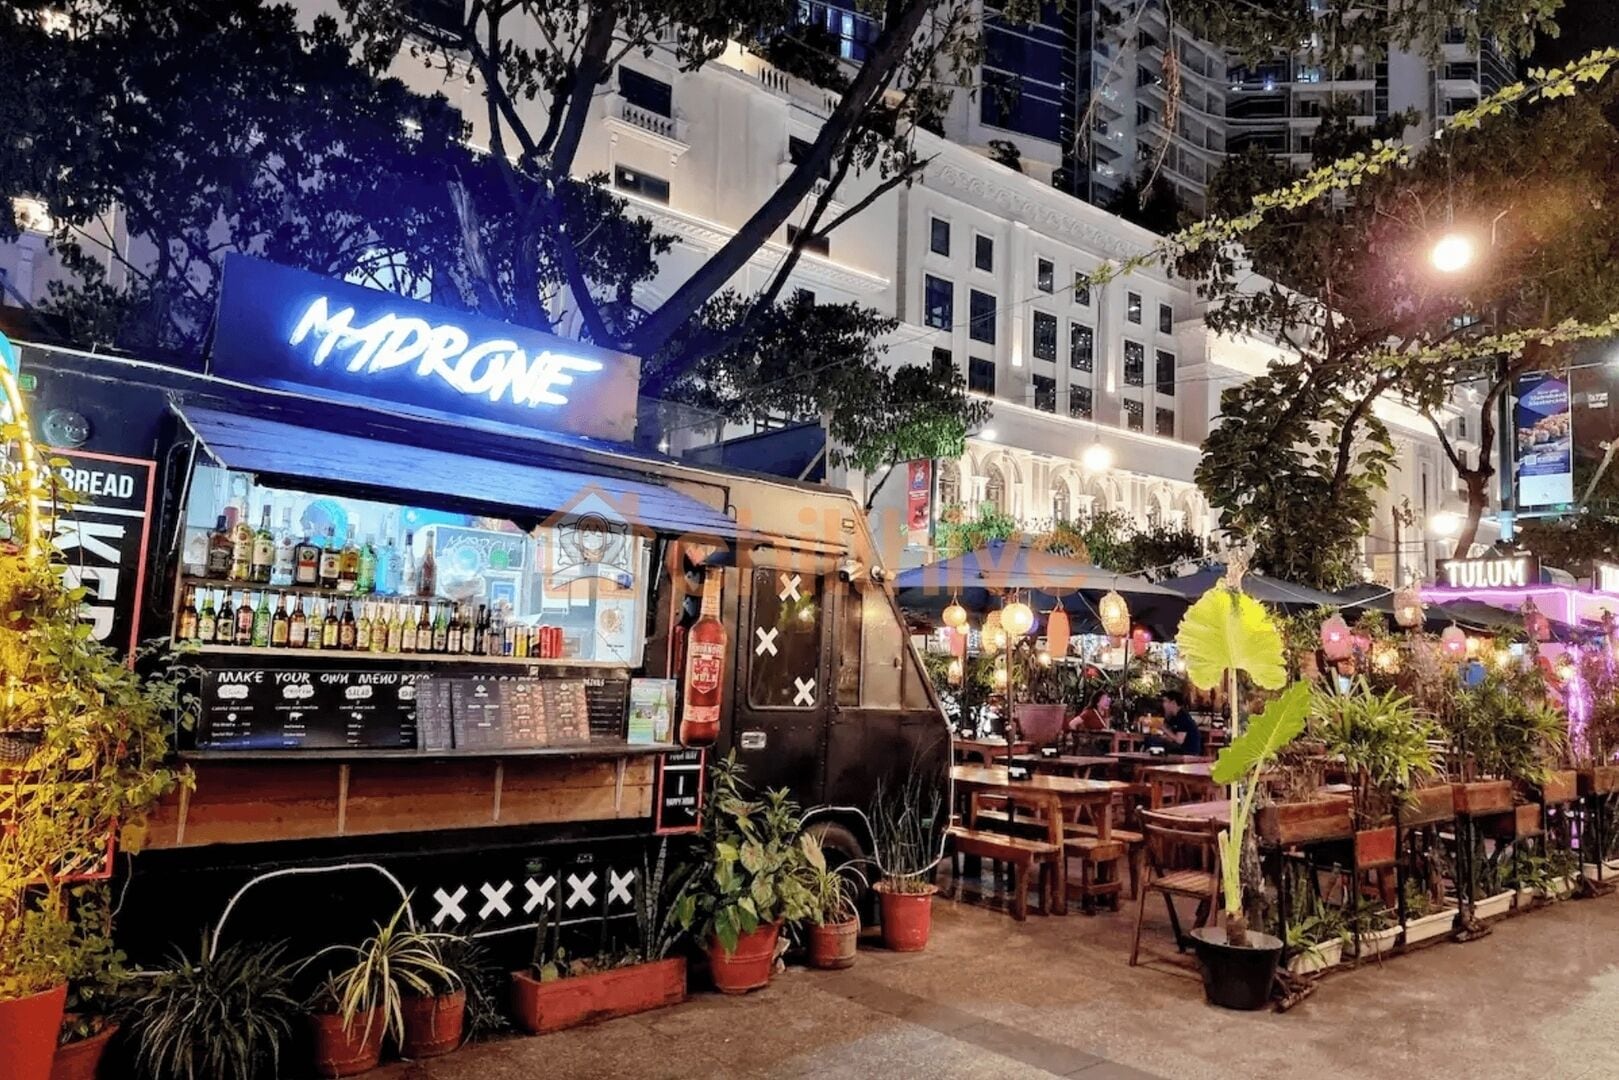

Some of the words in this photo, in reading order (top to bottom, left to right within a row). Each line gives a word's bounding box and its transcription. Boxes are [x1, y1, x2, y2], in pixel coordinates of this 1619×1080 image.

[289, 296, 603, 408] MADRONE
[1444, 561, 1525, 588] TULUM
[218, 671, 264, 683] MAKE
[275, 672, 310, 685] YOUR
[320, 673, 349, 684] OWN
[358, 674, 397, 684] MENU
